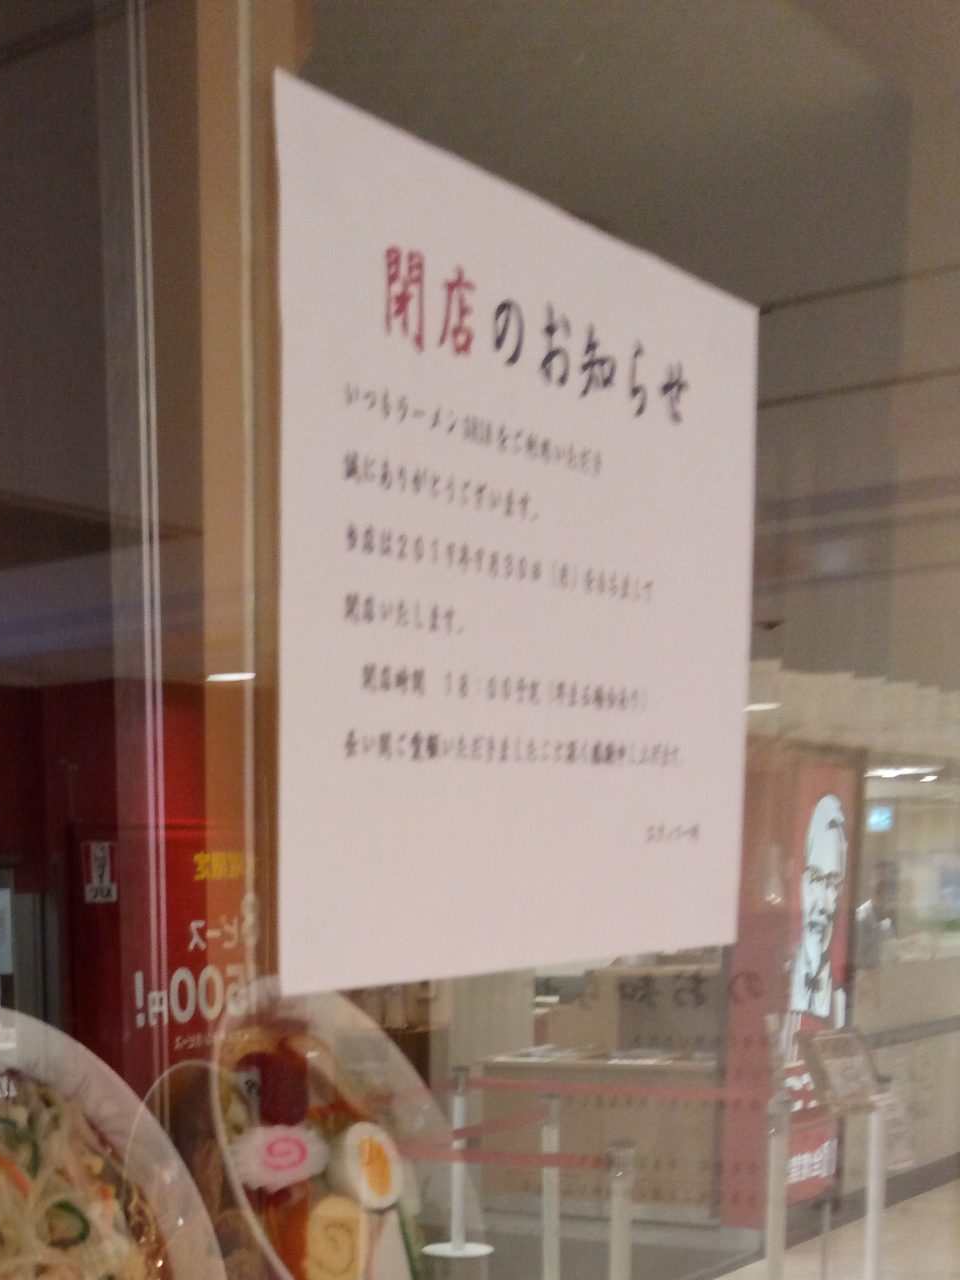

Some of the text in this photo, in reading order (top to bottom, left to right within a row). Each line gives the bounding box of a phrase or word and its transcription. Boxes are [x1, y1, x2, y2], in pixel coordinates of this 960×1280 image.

[383, 246, 689, 424] 閉店のお知らせ
